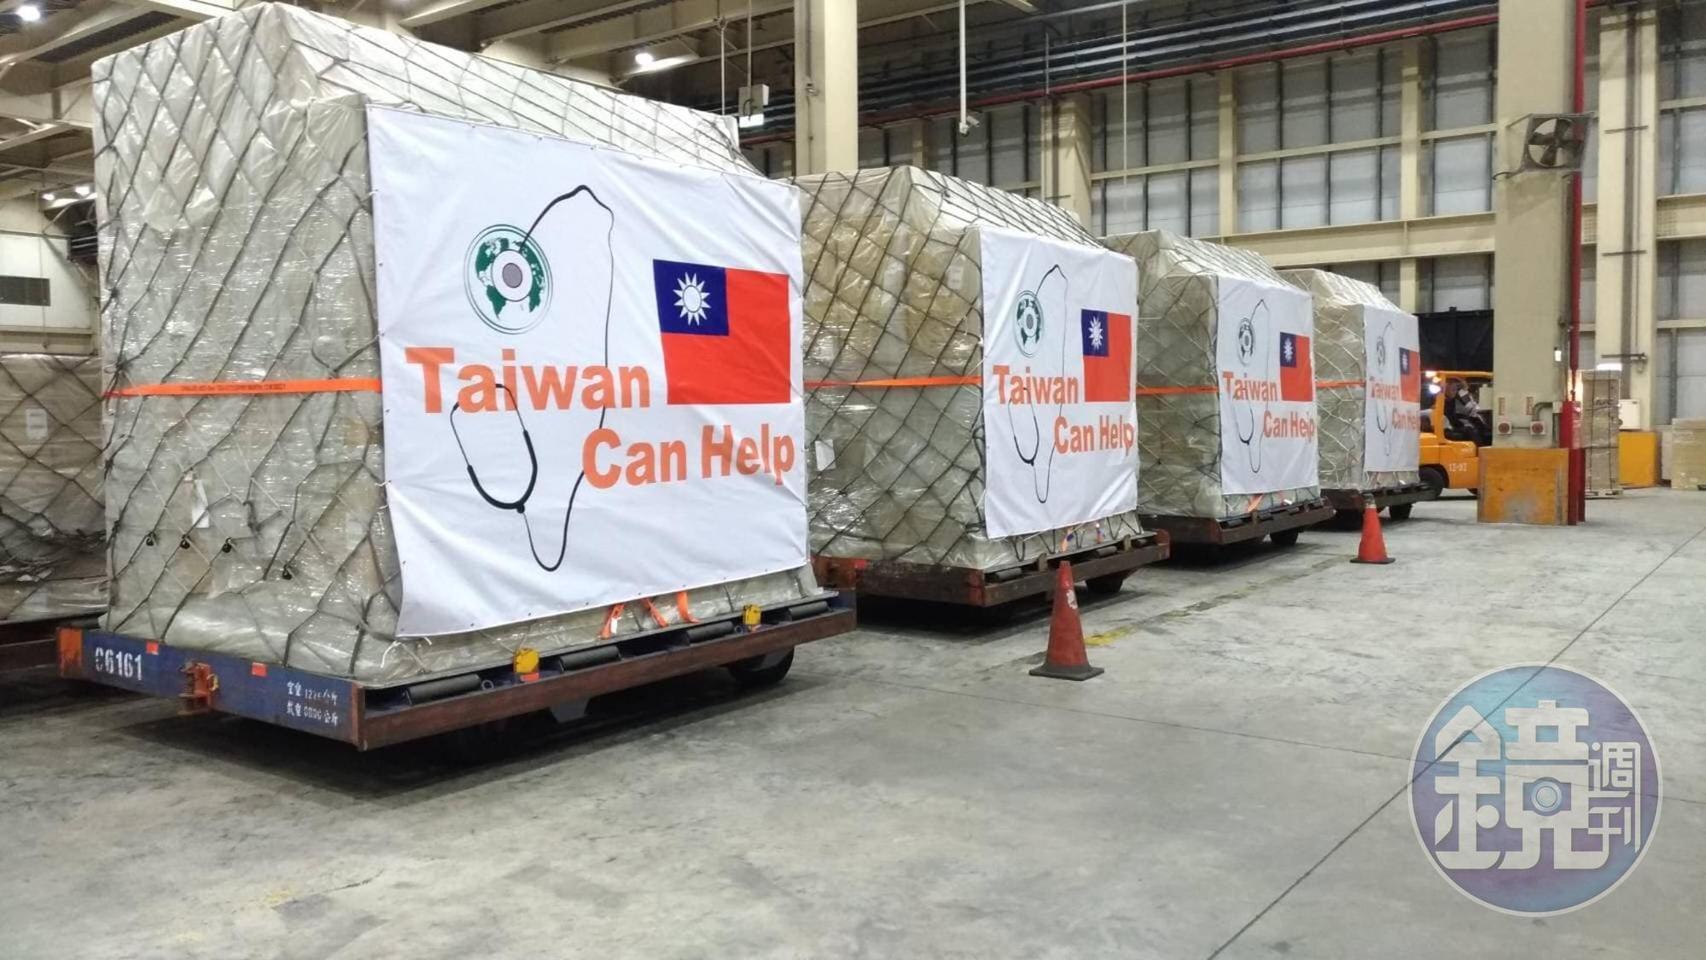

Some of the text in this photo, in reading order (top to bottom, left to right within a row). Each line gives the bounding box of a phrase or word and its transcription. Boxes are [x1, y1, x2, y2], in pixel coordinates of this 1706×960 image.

[405, 347, 650, 413] Taiwan
[992, 365, 1078, 405] Taiwan
[1222, 371, 1278, 401] Taiwan
[1054, 414, 1134, 456] Can Help
[1263, 410, 1288, 438] Can
[582, 423, 795, 489] Can Help
